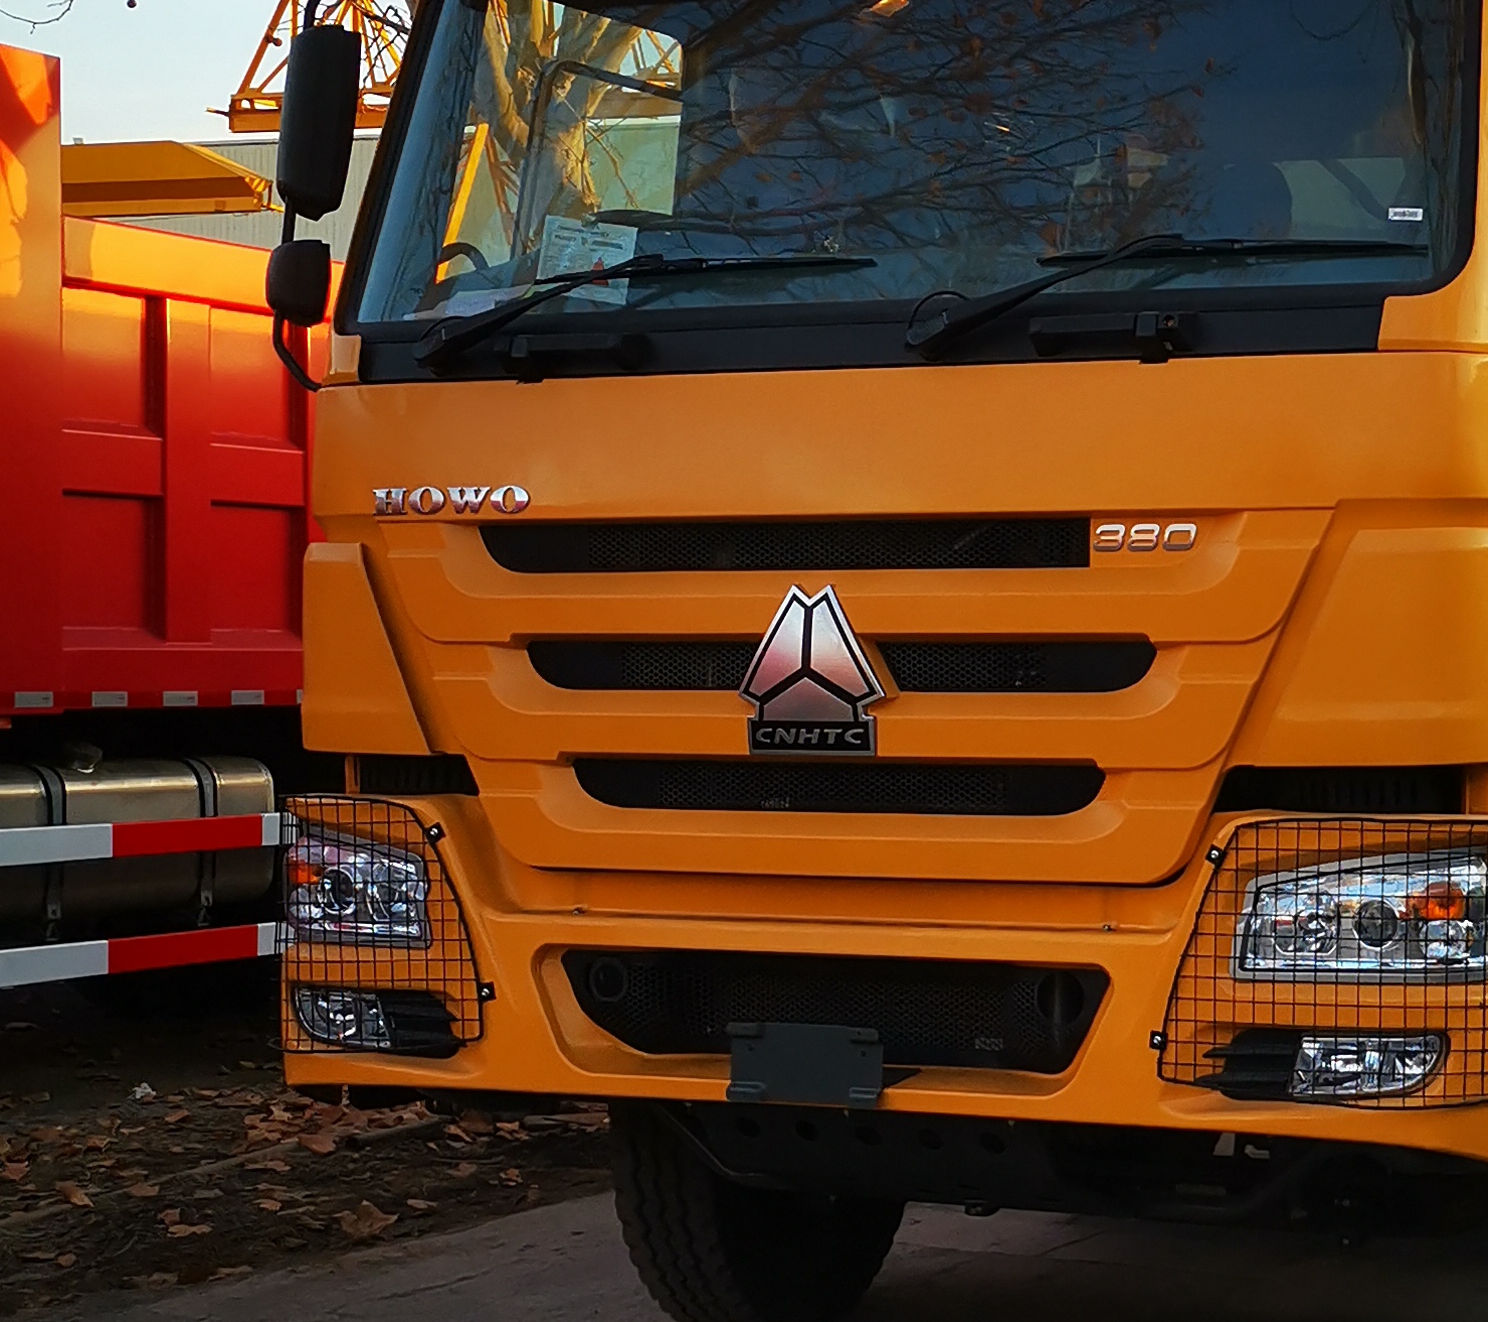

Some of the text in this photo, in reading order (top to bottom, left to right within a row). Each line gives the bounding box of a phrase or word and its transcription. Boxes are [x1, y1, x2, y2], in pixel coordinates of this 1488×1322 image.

[373, 485, 531, 516] HOWO
[1093, 523, 1198, 552] 380
[755, 727, 865, 745] CNHTC
